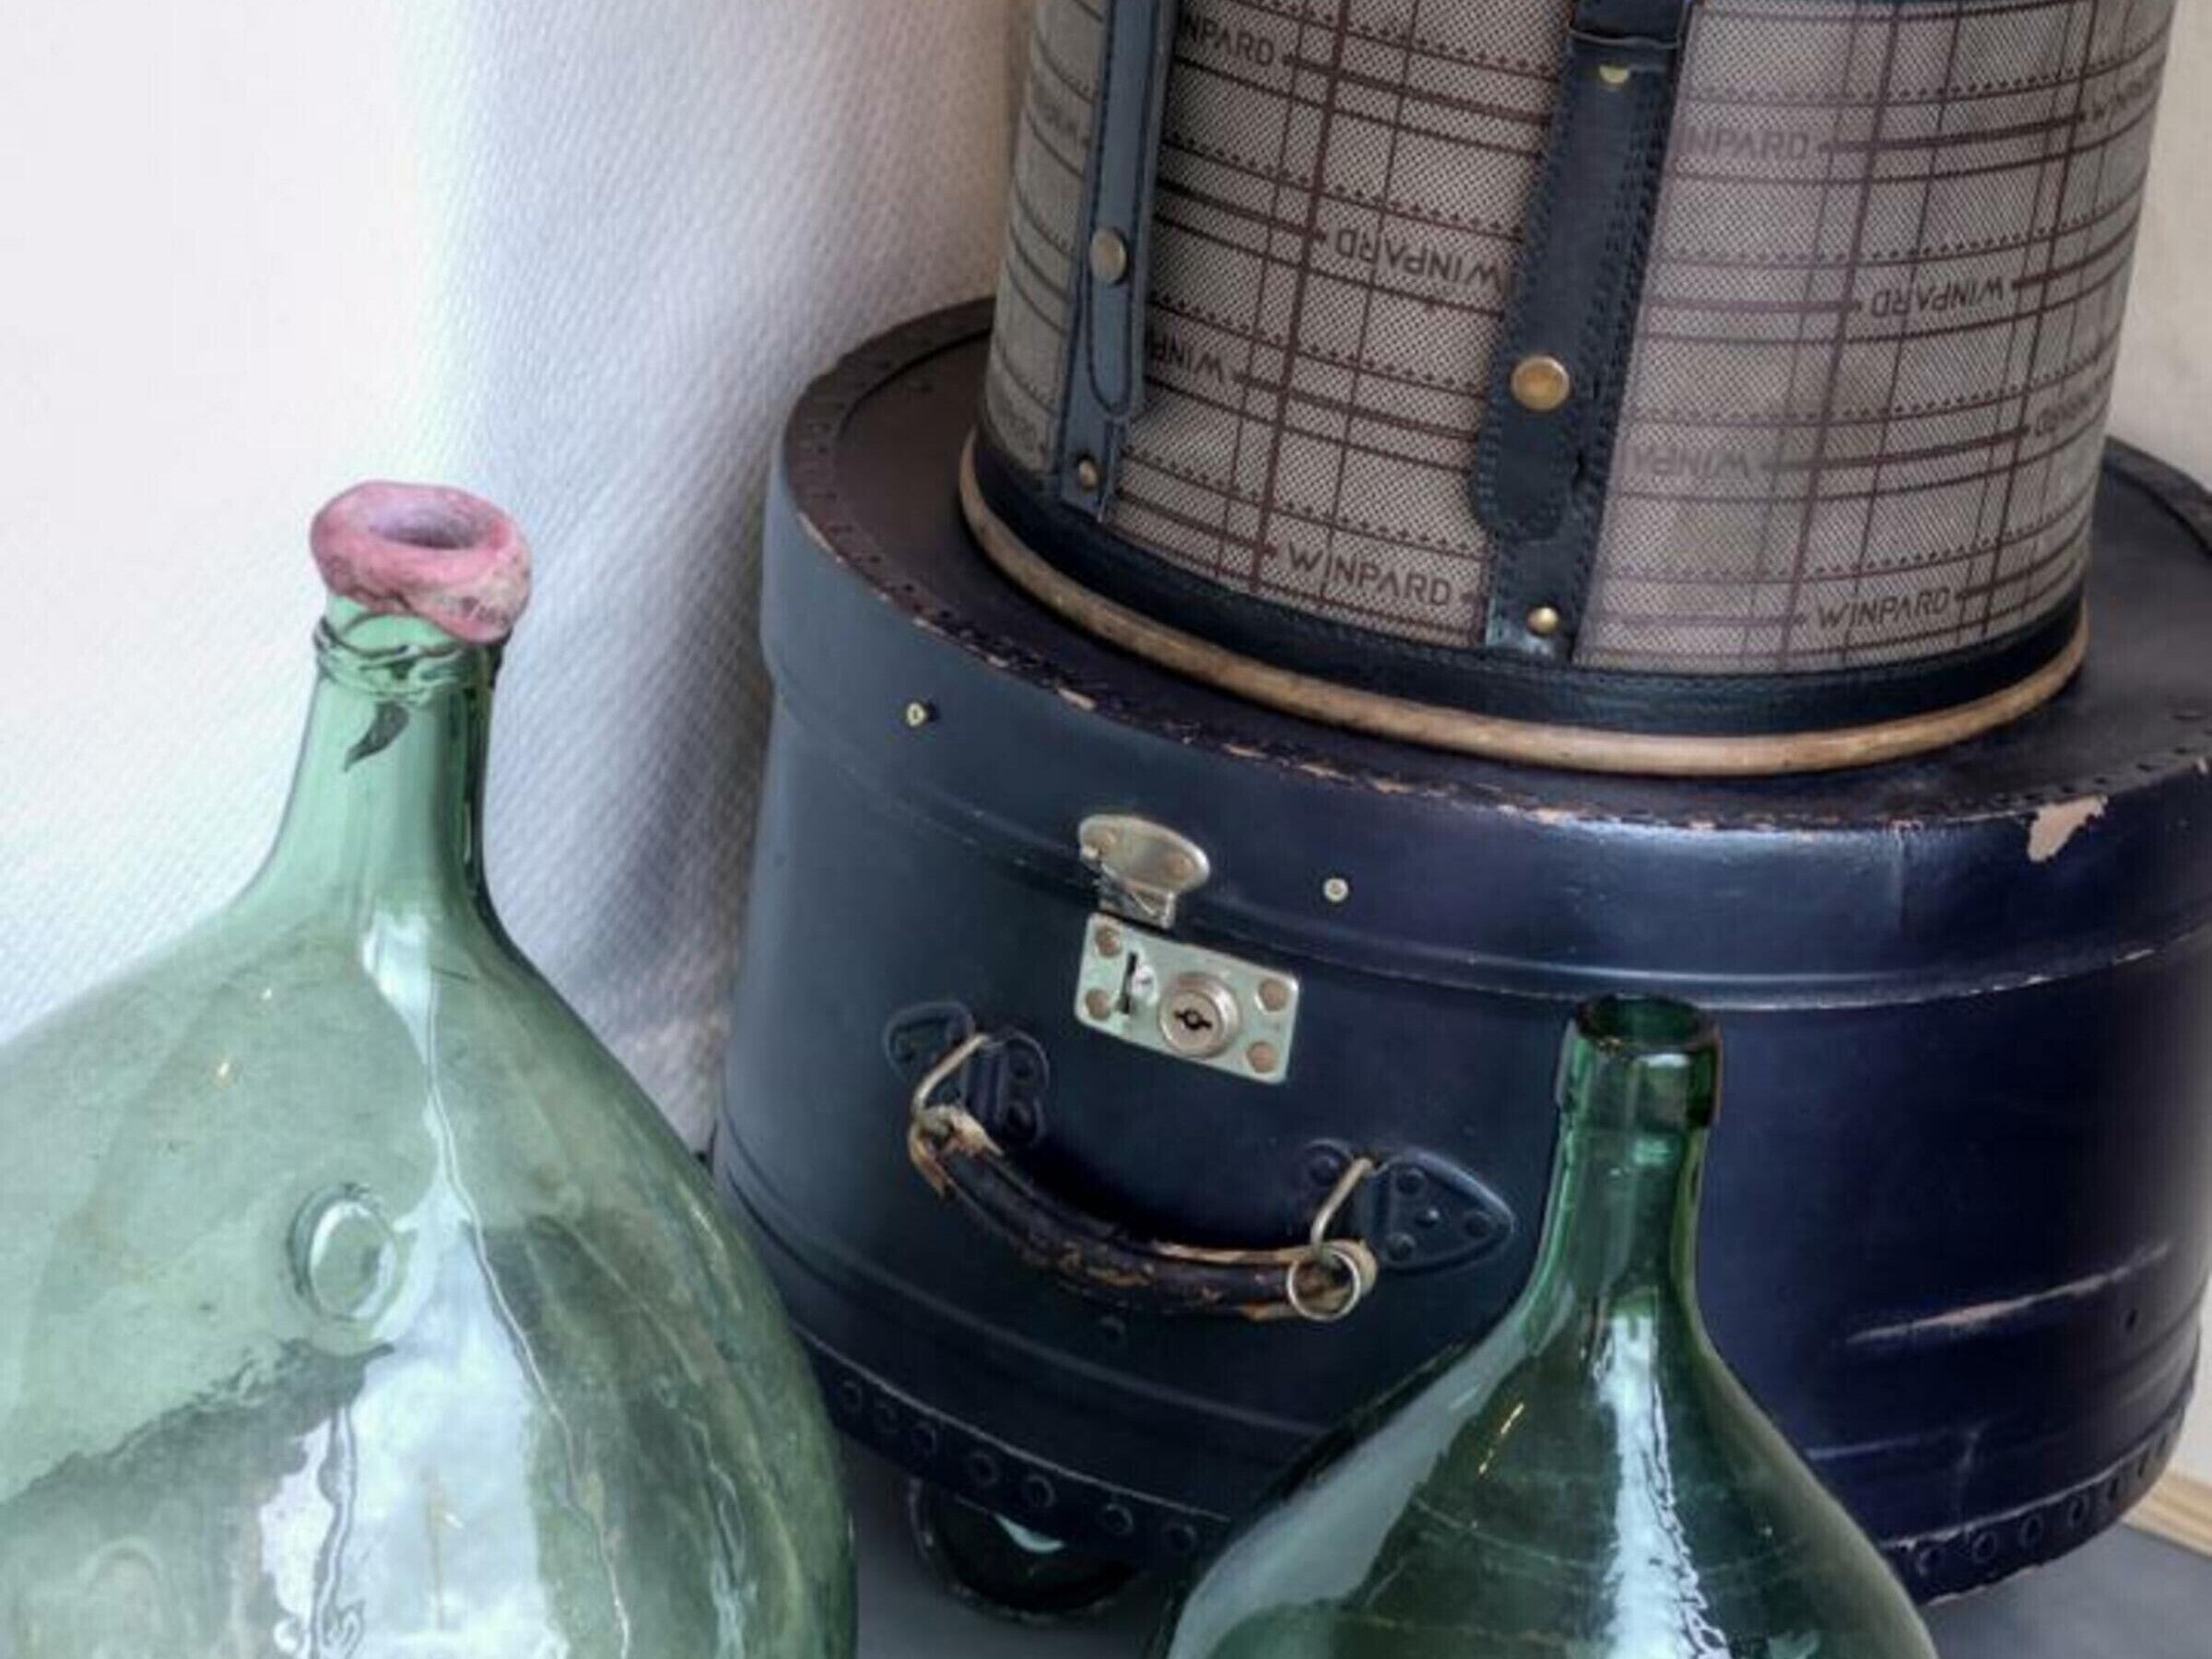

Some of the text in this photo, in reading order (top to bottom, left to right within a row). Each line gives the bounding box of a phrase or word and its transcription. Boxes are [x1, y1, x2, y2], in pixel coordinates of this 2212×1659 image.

[1336, 229, 1502, 293] WINPARD
[1872, 276, 2003, 318] WINPARD
[1146, 333, 1224, 384] WINP
[1288, 542, 1452, 606] WINPARD
[1818, 586, 1950, 628] WINPARD
